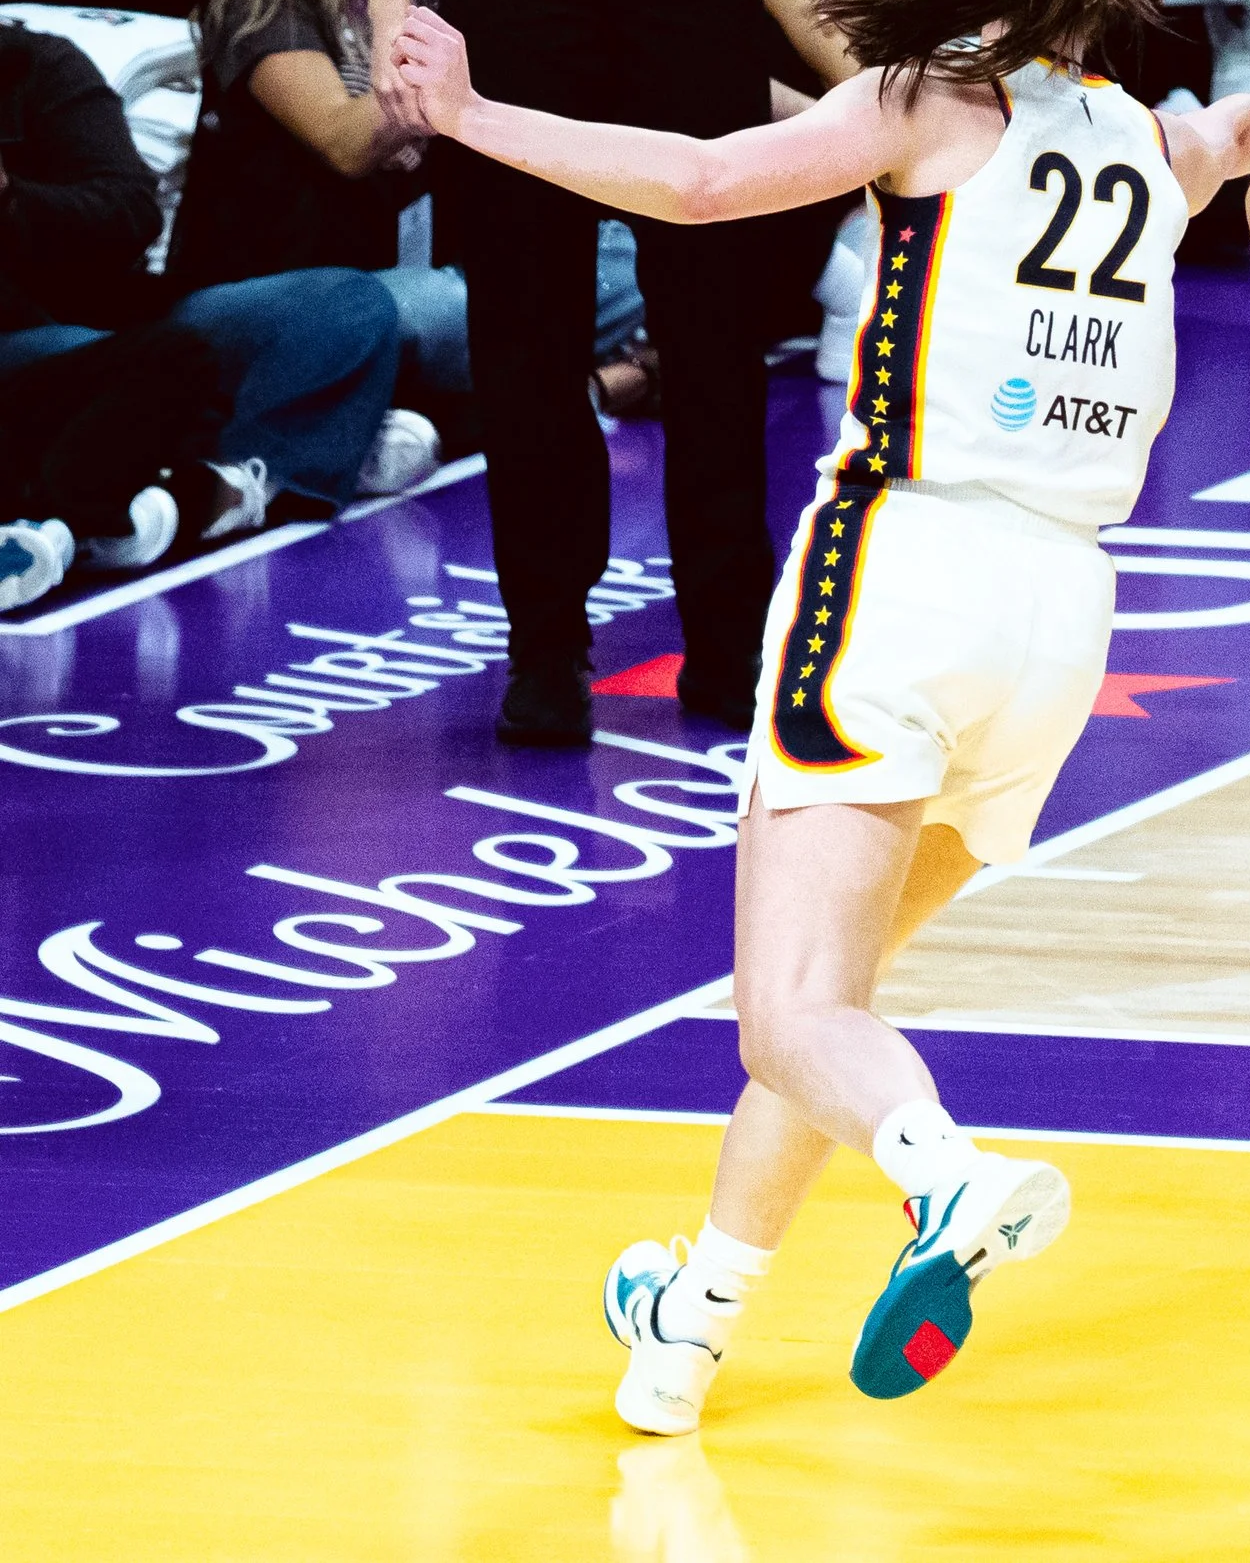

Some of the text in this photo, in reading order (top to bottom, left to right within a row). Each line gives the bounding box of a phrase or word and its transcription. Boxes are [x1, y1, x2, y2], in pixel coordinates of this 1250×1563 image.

[1015, 150, 1151, 304] 22
[1025, 308, 1124, 369] CLARK
[1042, 394, 1138, 439] AT&T
